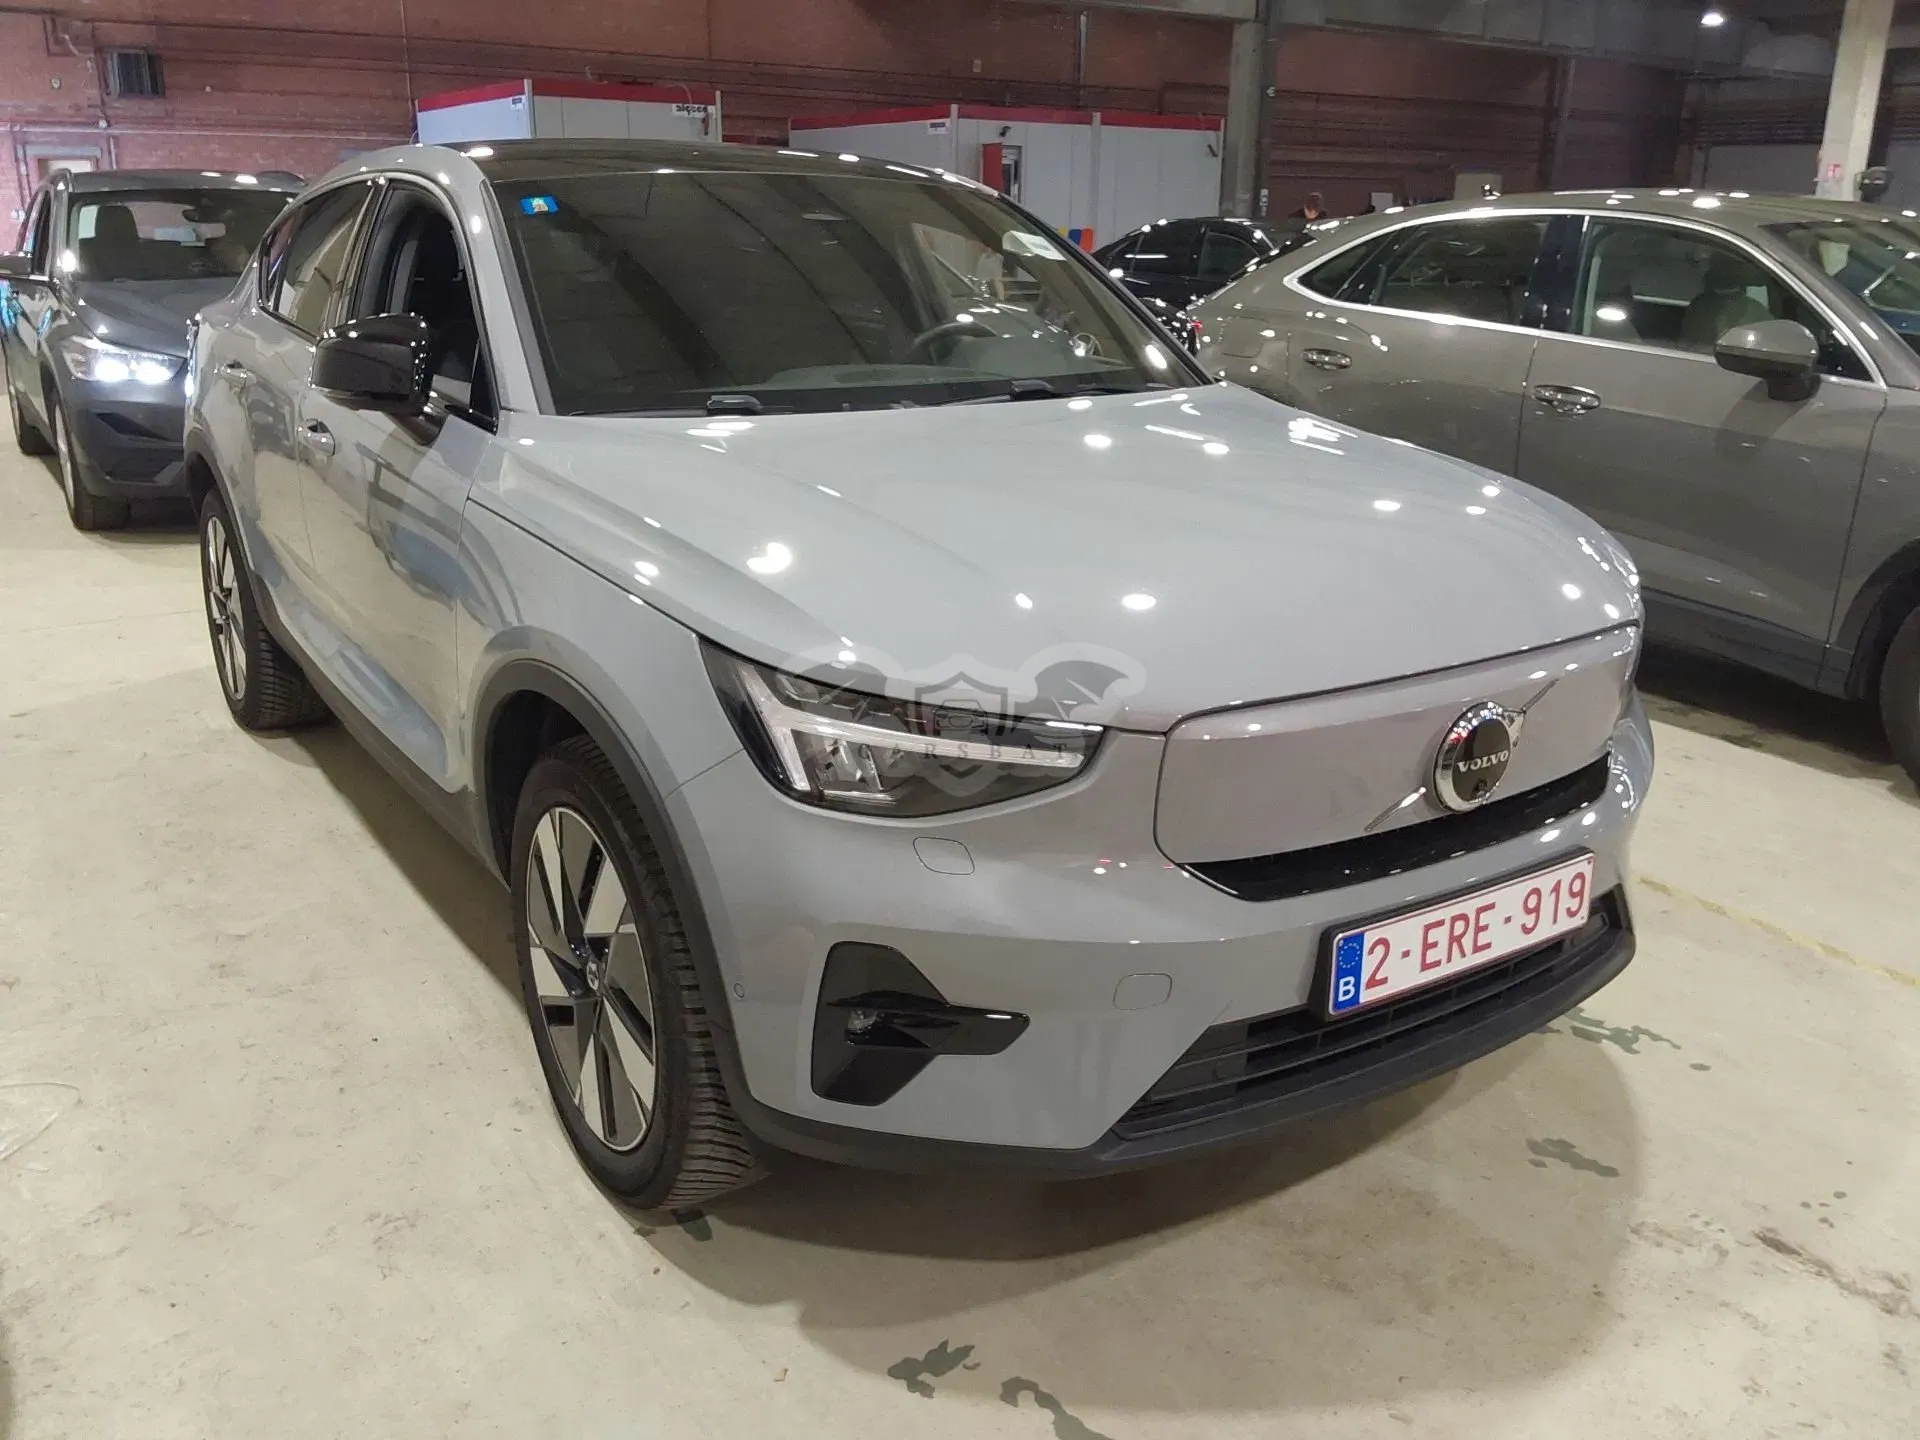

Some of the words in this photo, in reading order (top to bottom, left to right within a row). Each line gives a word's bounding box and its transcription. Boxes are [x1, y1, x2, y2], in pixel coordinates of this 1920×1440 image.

[1457, 750, 1509, 773] VOLVO
[1364, 871, 1586, 991] 2-ERE-919
[1338, 976, 1356, 1002] B
